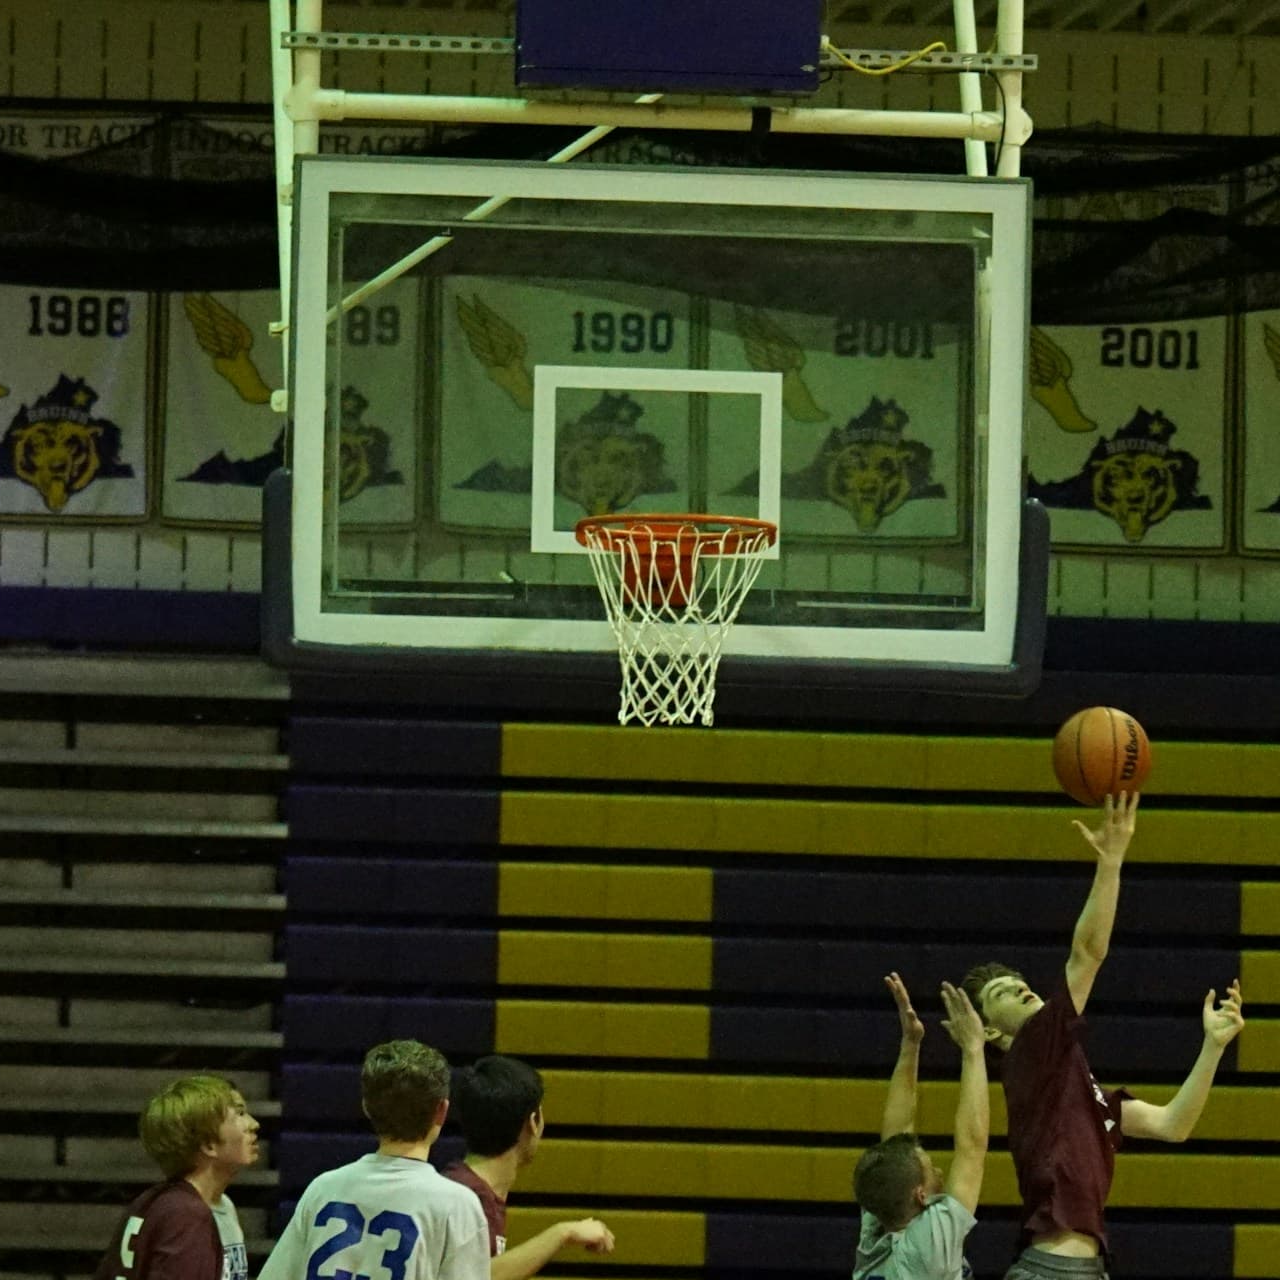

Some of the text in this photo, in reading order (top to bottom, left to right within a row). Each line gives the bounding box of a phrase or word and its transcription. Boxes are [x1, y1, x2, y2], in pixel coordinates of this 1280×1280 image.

[28, 295, 130, 338] 1988
[573, 311, 674, 353] 1990
[835, 317, 935, 359] 2001
[1100, 327, 1200, 370] 2001
[1119, 719, 1139, 781] Wilson
